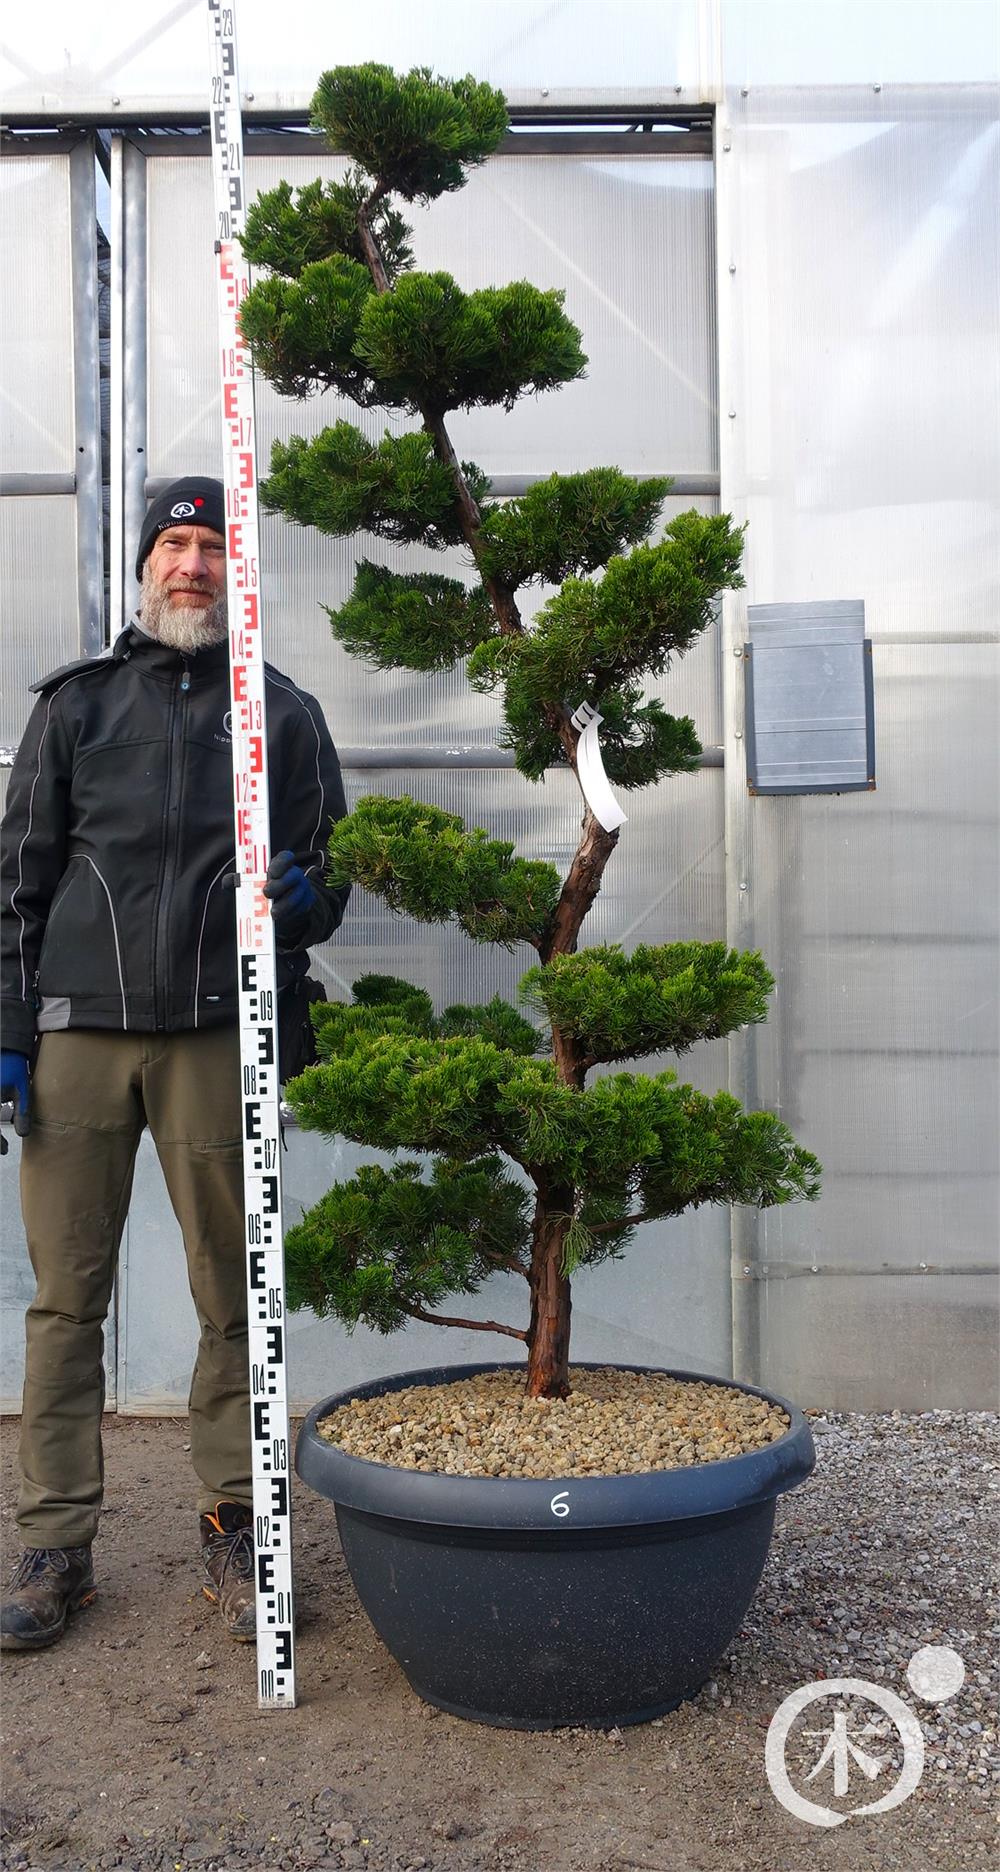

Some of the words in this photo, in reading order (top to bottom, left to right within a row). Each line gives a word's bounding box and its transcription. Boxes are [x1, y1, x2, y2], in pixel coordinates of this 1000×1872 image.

[212, 77, 222, 104] 22
[229, 143, 240, 170] 21
[219, 211, 229, 239] 20
[222, 349, 235, 377] 18
[240, 417, 252, 446] 17
[226, 488, 239, 517] 16
[244, 558, 257, 587] 15
[231, 630, 244, 659] 14
[249, 700, 262, 730] 13
[236, 773, 249, 803] 12
[254, 844, 267, 874] 11
[239, 917, 252, 947] 10
[260, 990, 273, 1021] 09
[243, 1065, 256, 1095] 08
[264, 1138, 277, 1169] 07
[248, 1213, 261, 1244] 06
[269, 1288, 282, 1319] 05
[252, 1363, 265, 1395] 04
[273, 1439, 286, 1471] 03
[551, 1491, 570, 1517] 6
[256, 1516, 270, 1547] 02
[277, 1592, 291, 1624] 01
